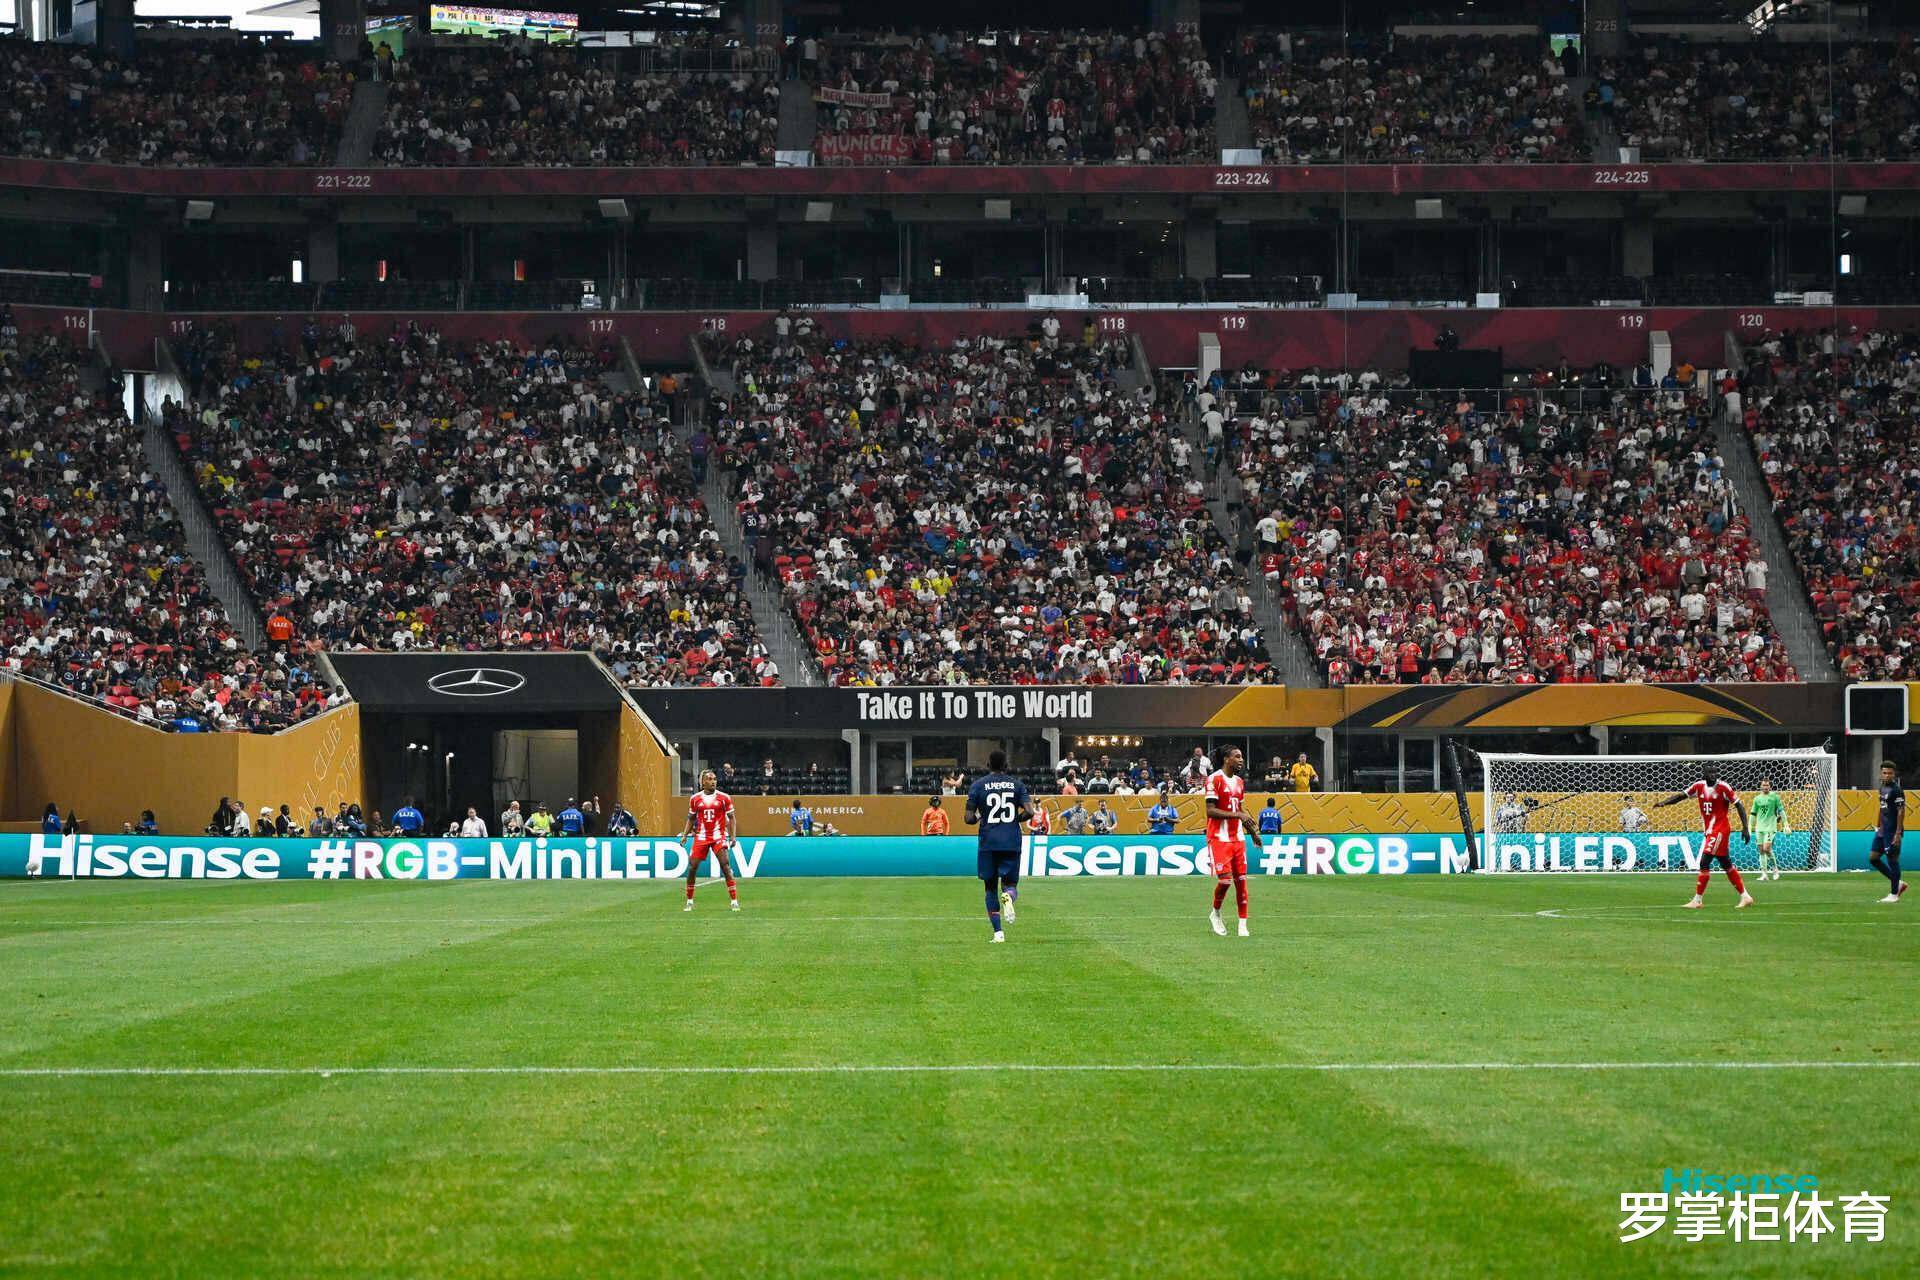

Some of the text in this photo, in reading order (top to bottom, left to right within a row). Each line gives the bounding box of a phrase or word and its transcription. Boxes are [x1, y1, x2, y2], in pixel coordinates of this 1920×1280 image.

[336, 23, 358, 36] 221
[317, 175, 371, 188] 221-222
[1216, 172, 1270, 185] 223-224
[1594, 171, 1649, 183] 224-225
[63, 315, 87, 329] 116
[589, 319, 613, 332] 117
[1101, 317, 1126, 330] 118
[1222, 316, 1247, 329] 119
[1619, 315, 1644, 328] 119
[1739, 314, 1763, 327] 120
[857, 691, 1093, 720] Take It To The World
[815, 807, 864, 815] AMERICA
[986, 792, 1016, 824] 25
[27, 834, 281, 879] Hisense
[307, 837, 694, 880] #RGB-MiniLED
